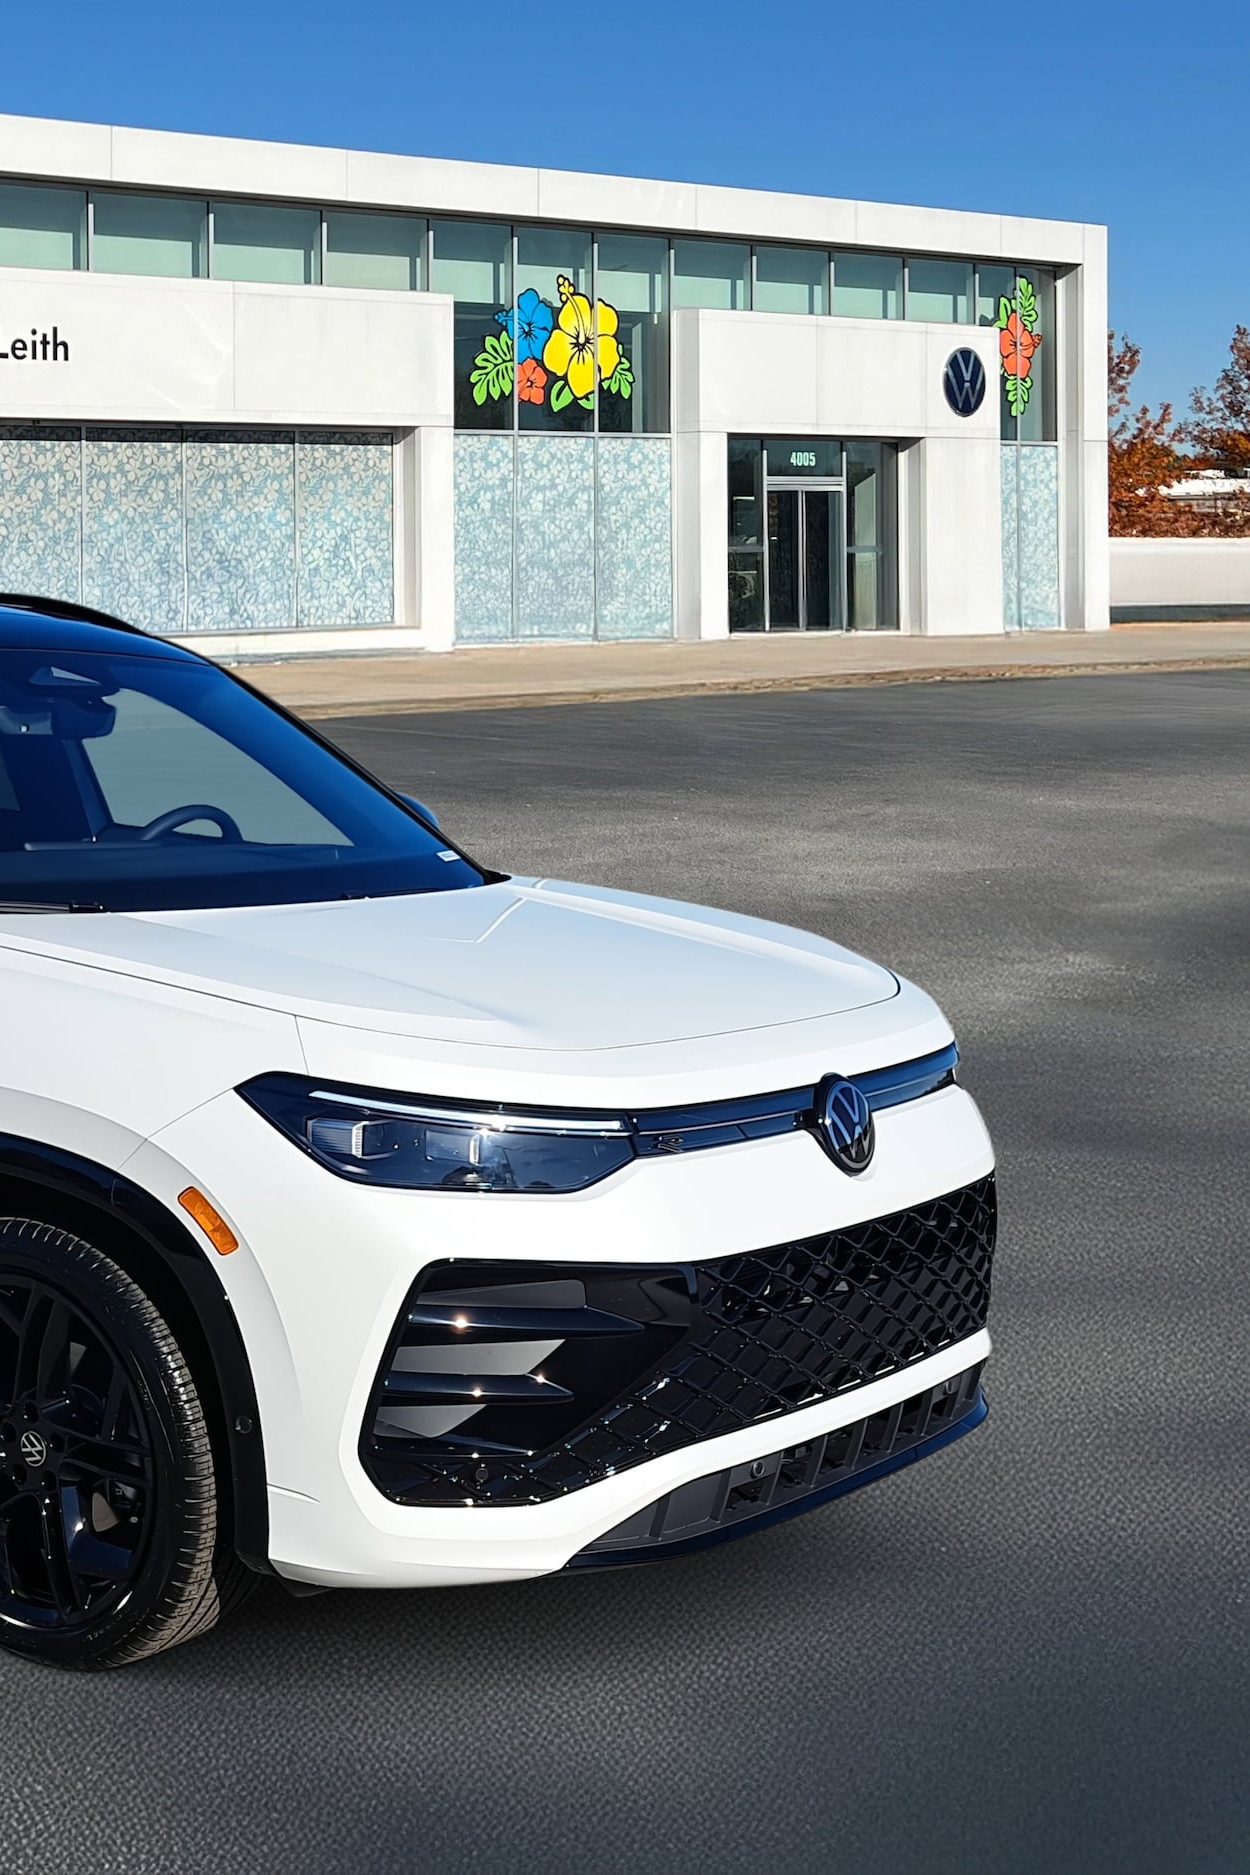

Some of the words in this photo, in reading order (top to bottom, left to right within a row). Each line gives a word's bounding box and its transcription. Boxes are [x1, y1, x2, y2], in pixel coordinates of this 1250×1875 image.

[945, 349, 985, 413] VW
[790, 451, 816, 466] 4005
[827, 1082, 871, 1166] VW
[21, 1431, 46, 1467] VW
